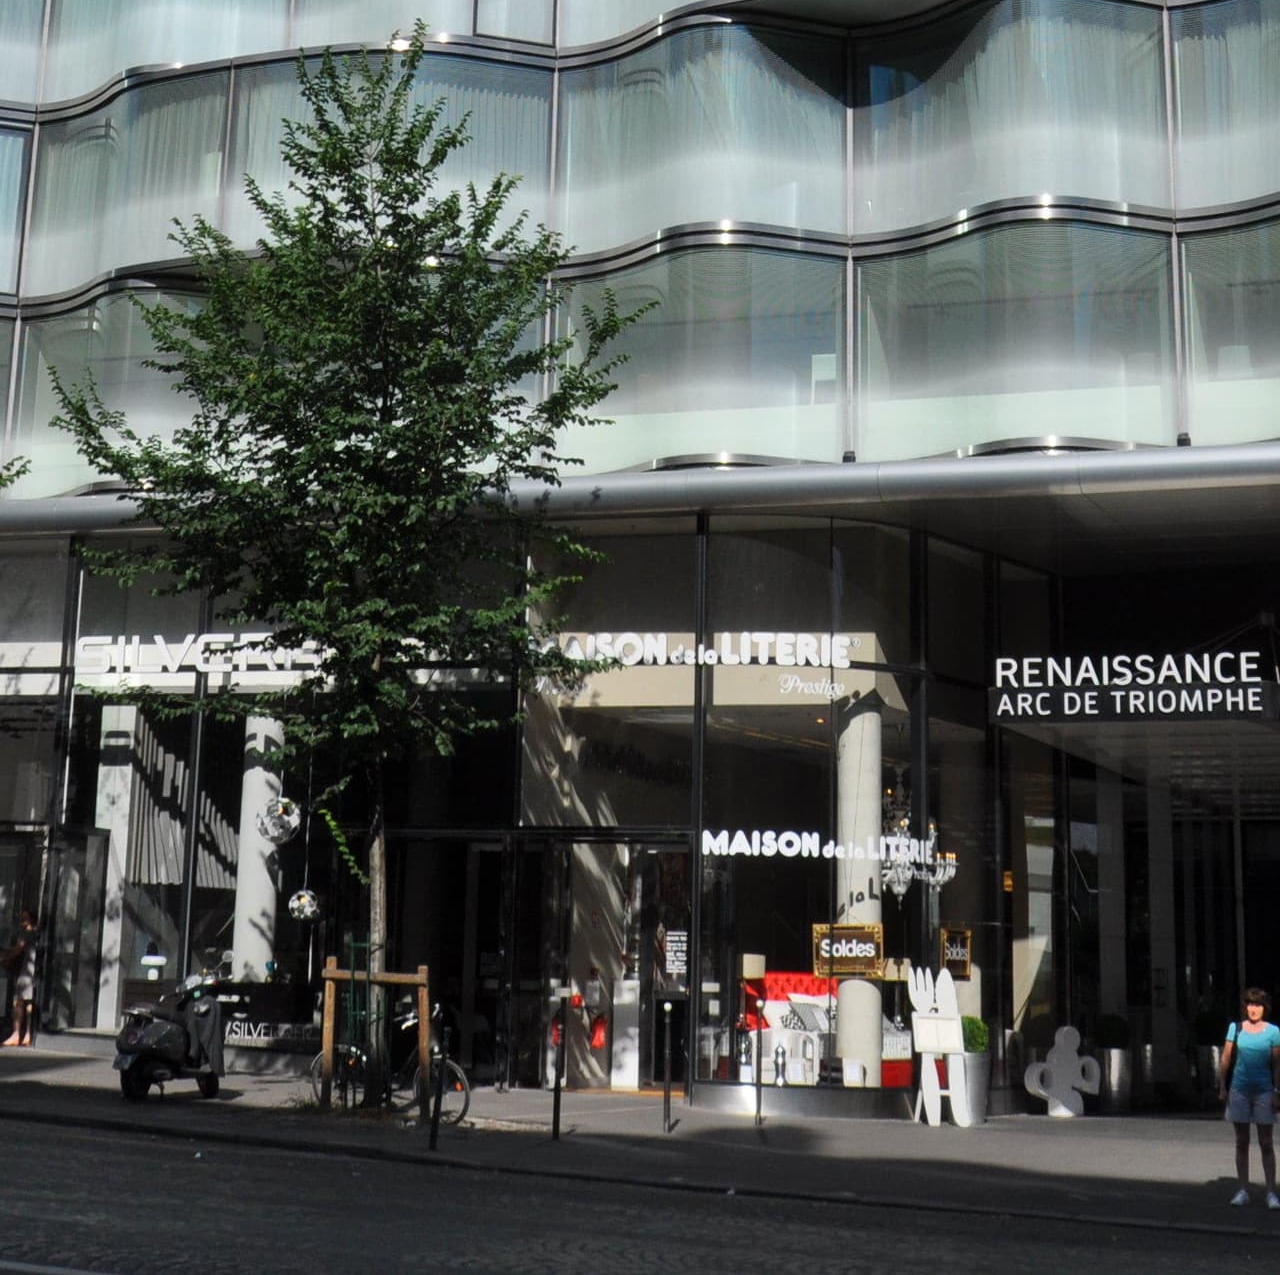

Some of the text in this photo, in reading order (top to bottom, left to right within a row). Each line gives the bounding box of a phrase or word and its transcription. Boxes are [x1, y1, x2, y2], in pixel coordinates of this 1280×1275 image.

[995, 651, 1261, 688] RENAISSANCE
[778, 673, 843, 700] Prestige
[996, 688, 1263, 717] ARC DE TRIOMPHE
[701, 828, 820, 858] MAISON
[821, 938, 876, 958] Soldes
[945, 941, 969, 961] Soldes
